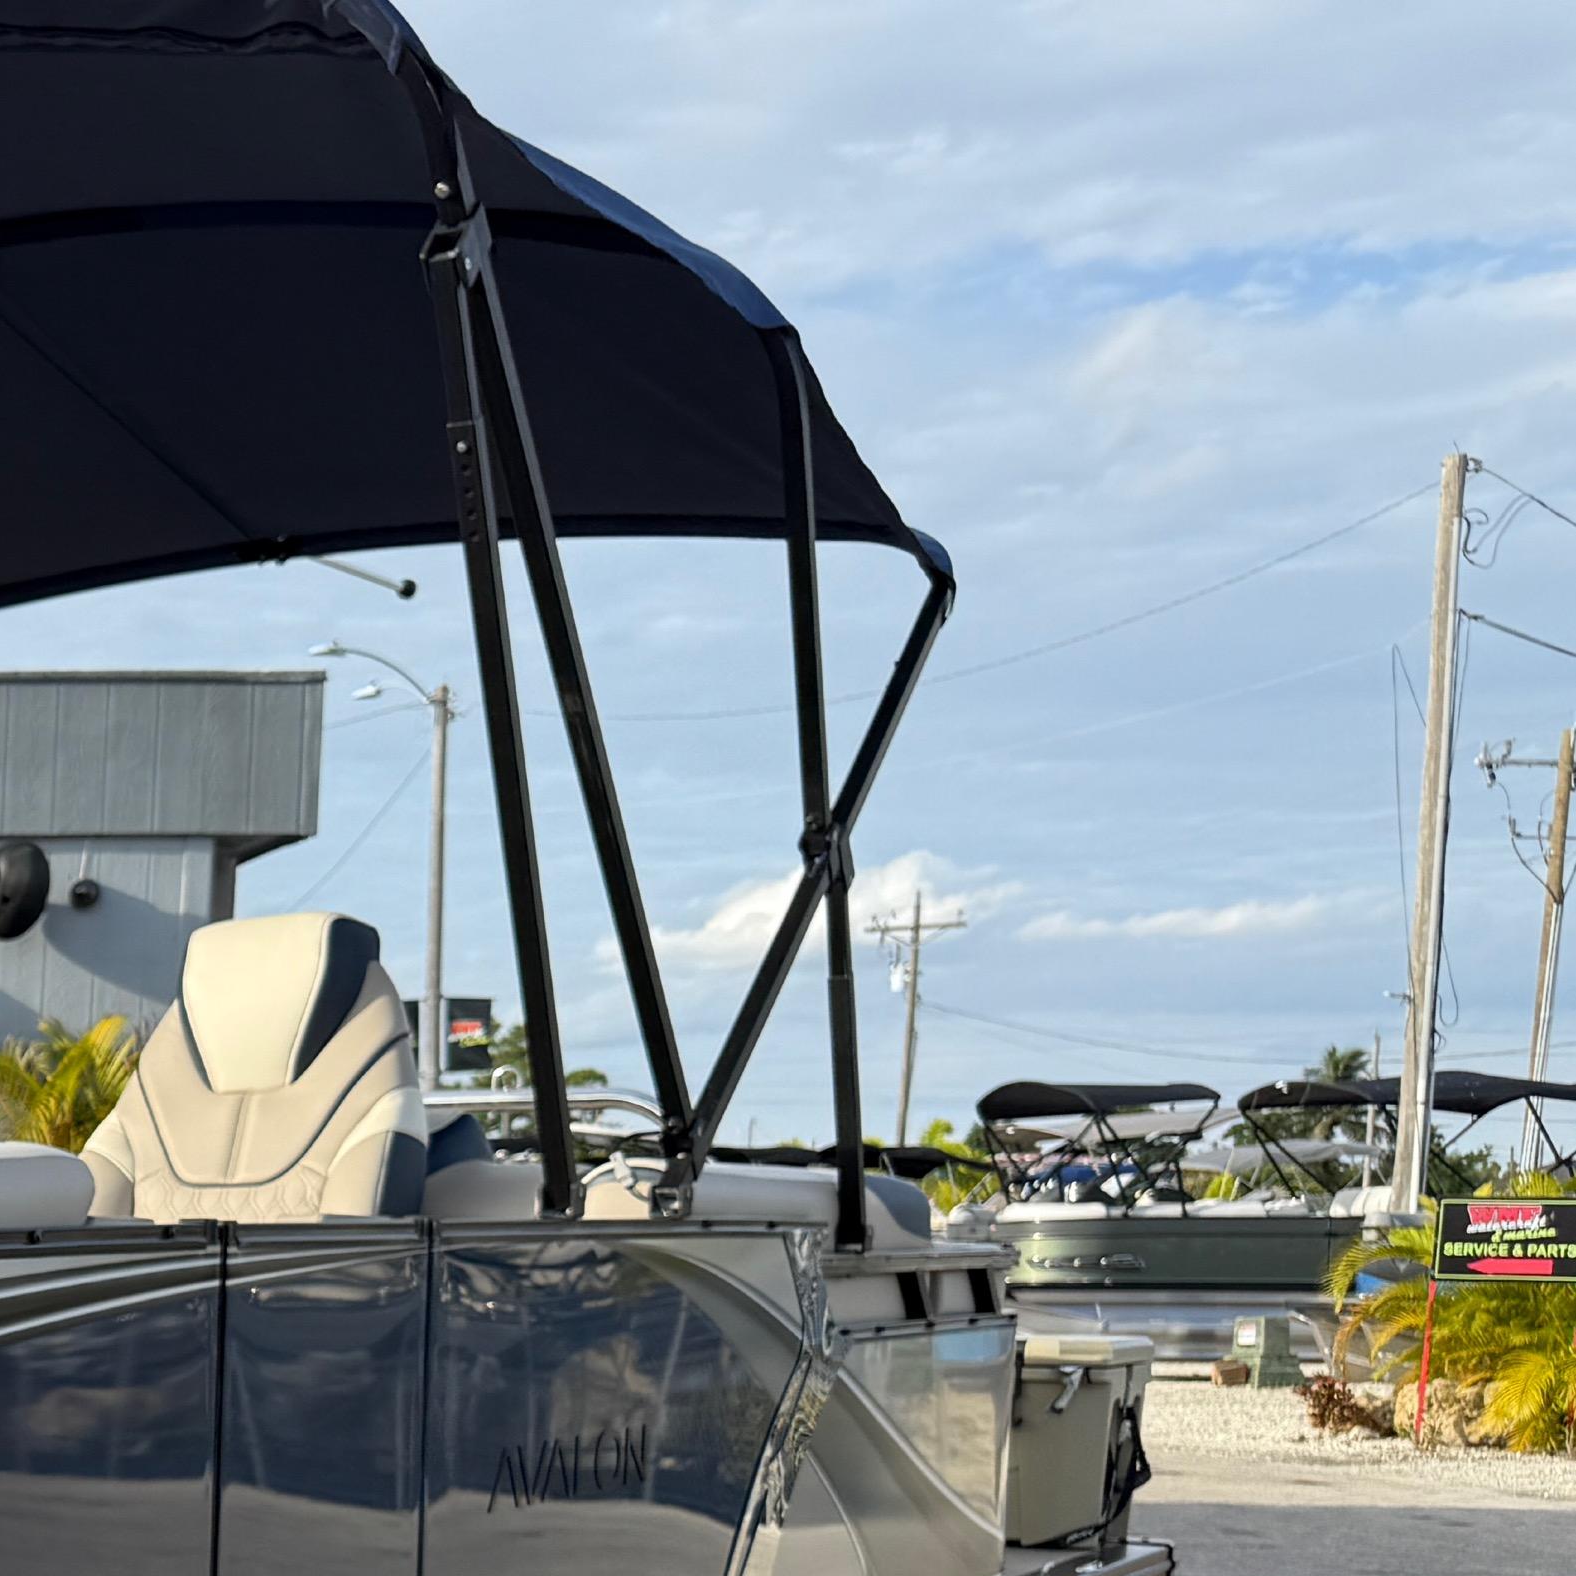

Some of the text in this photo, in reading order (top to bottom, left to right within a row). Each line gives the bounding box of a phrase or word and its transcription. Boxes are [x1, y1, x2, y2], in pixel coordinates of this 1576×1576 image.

[1443, 1241, 1576, 1259] SERVICE & PARTS
